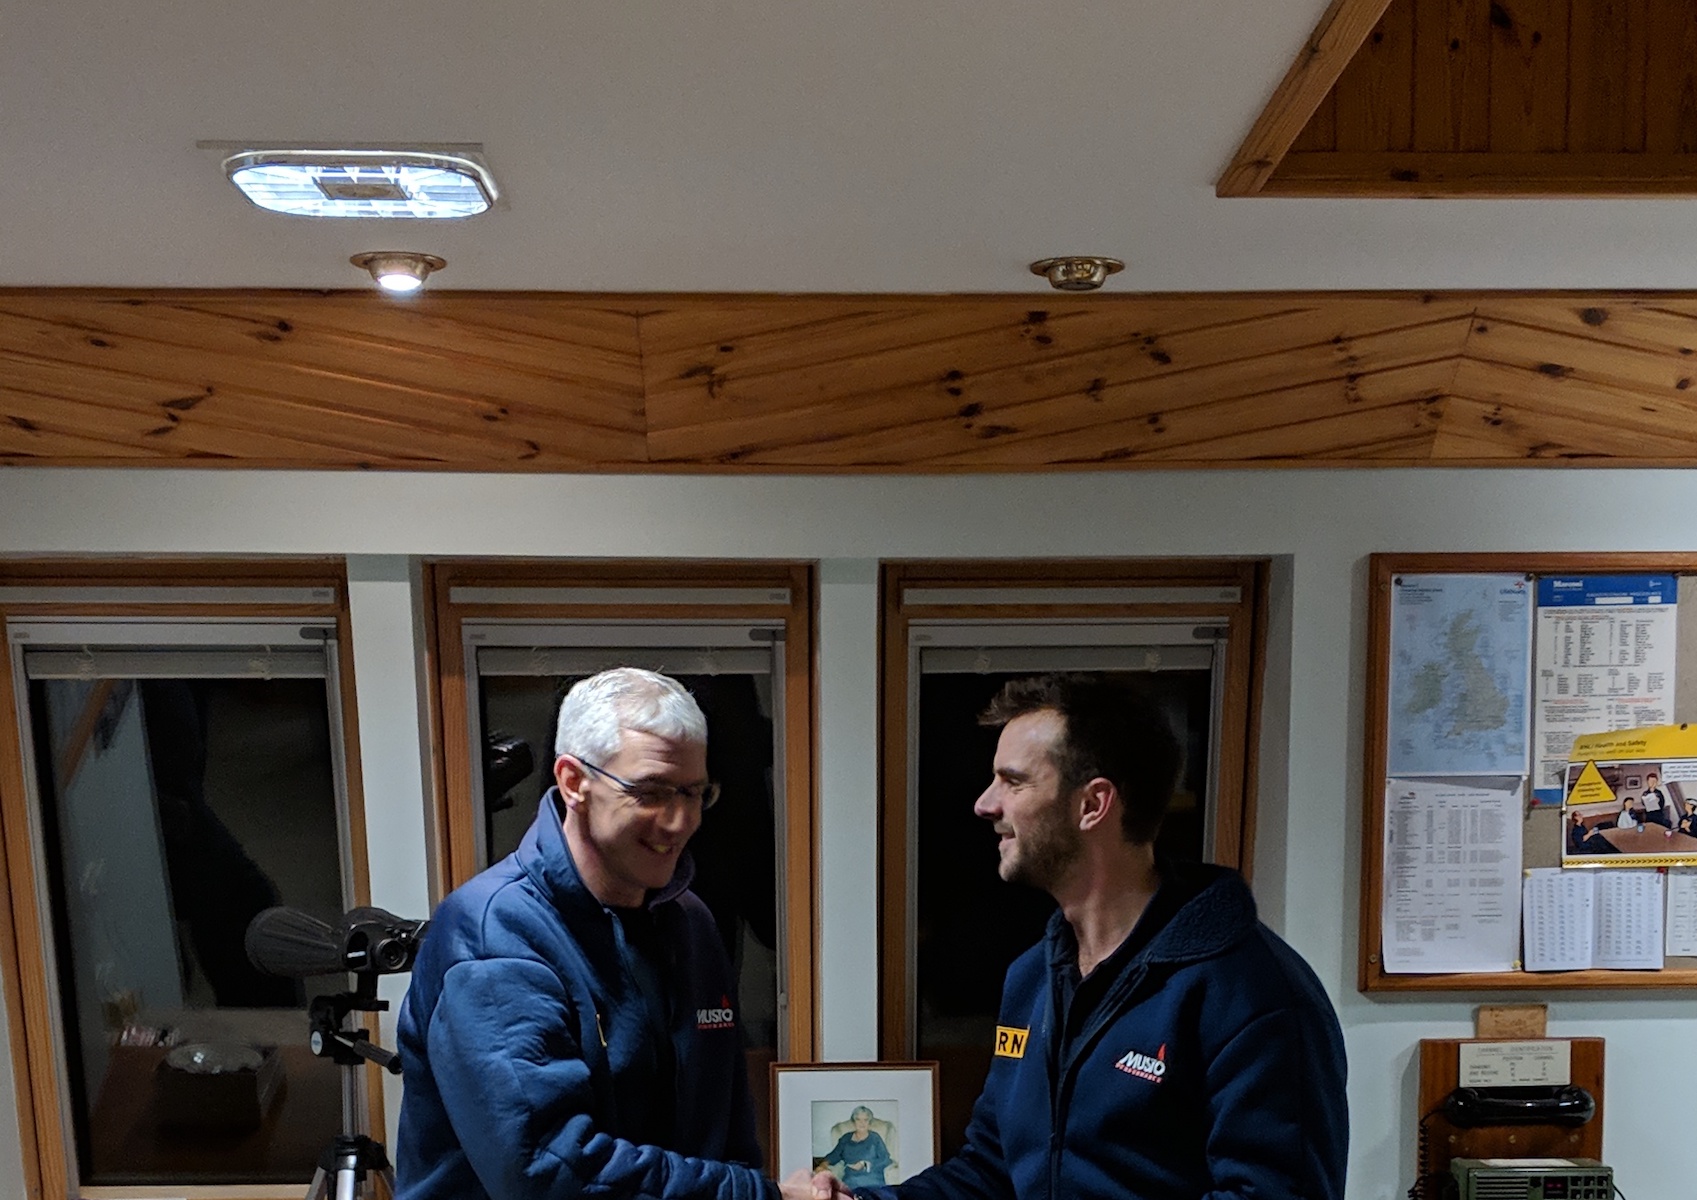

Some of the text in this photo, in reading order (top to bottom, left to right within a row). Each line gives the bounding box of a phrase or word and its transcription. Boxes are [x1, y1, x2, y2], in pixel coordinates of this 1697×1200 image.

[1628, 739, 1647, 747] Safety
[696, 1008, 734, 1024] MUSTO
[997, 1031, 1024, 1054] RN
[1118, 1050, 1166, 1077] MUSTO
